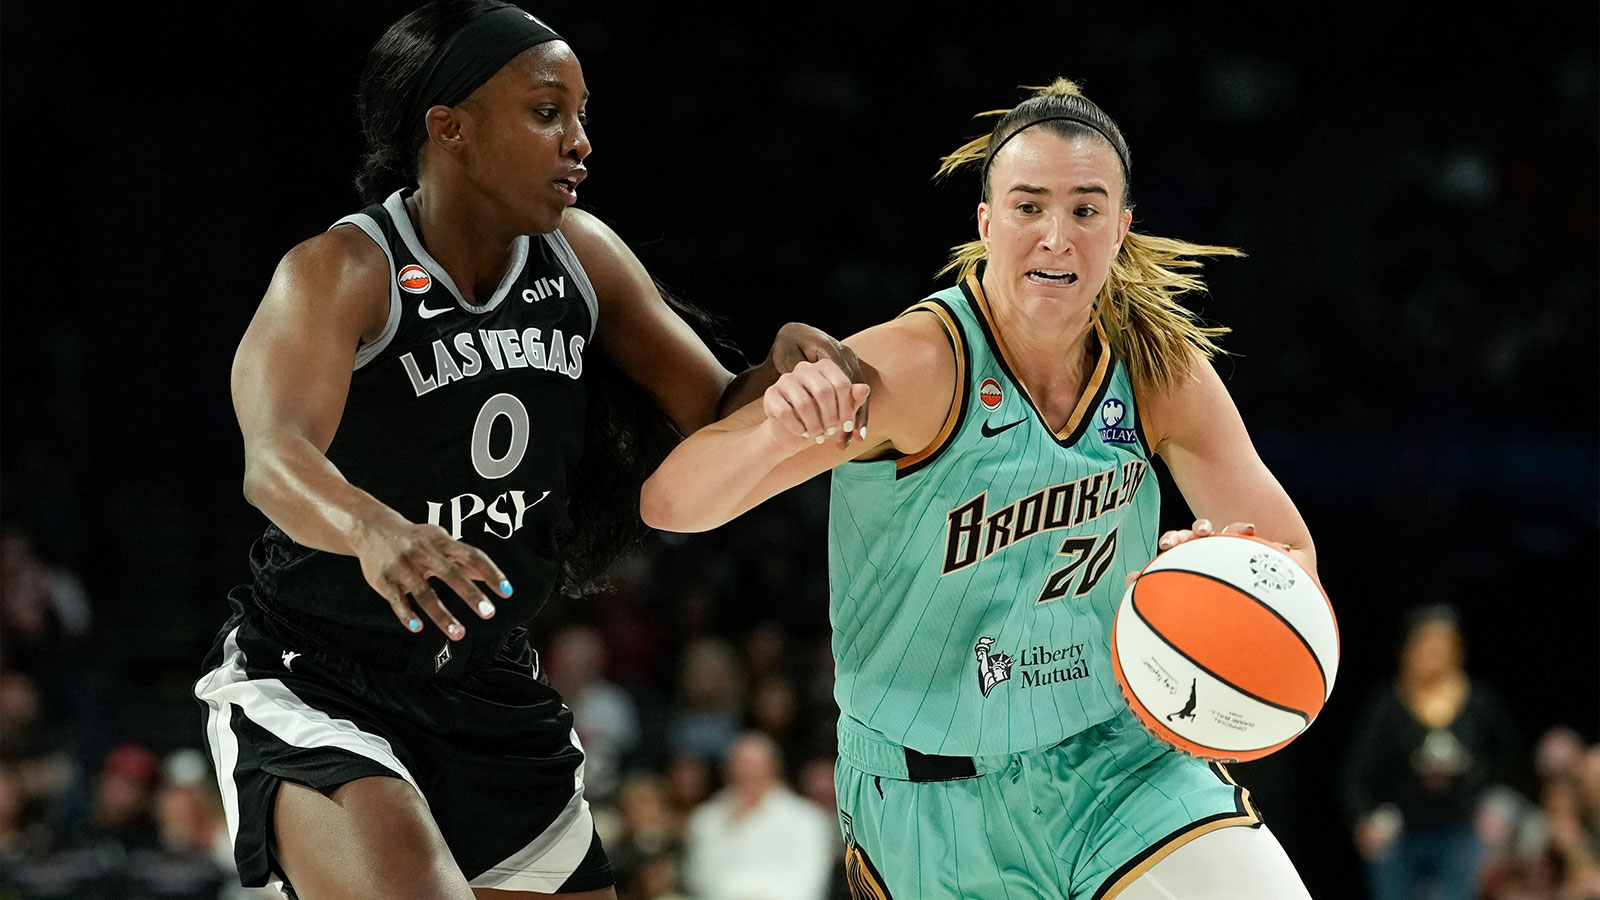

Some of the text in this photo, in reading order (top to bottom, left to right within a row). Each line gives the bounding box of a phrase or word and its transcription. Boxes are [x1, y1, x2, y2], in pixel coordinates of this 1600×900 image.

[522, 276, 565, 303] ally
[399, 327, 585, 397] LAS VEGAS
[471, 393, 529, 479] 0
[940, 459, 1147, 577] BROOKLYN
[1035, 524, 1120, 605] 20
[1020, 643, 1084, 666] Liberty
[1020, 659, 1090, 689] Mutual
